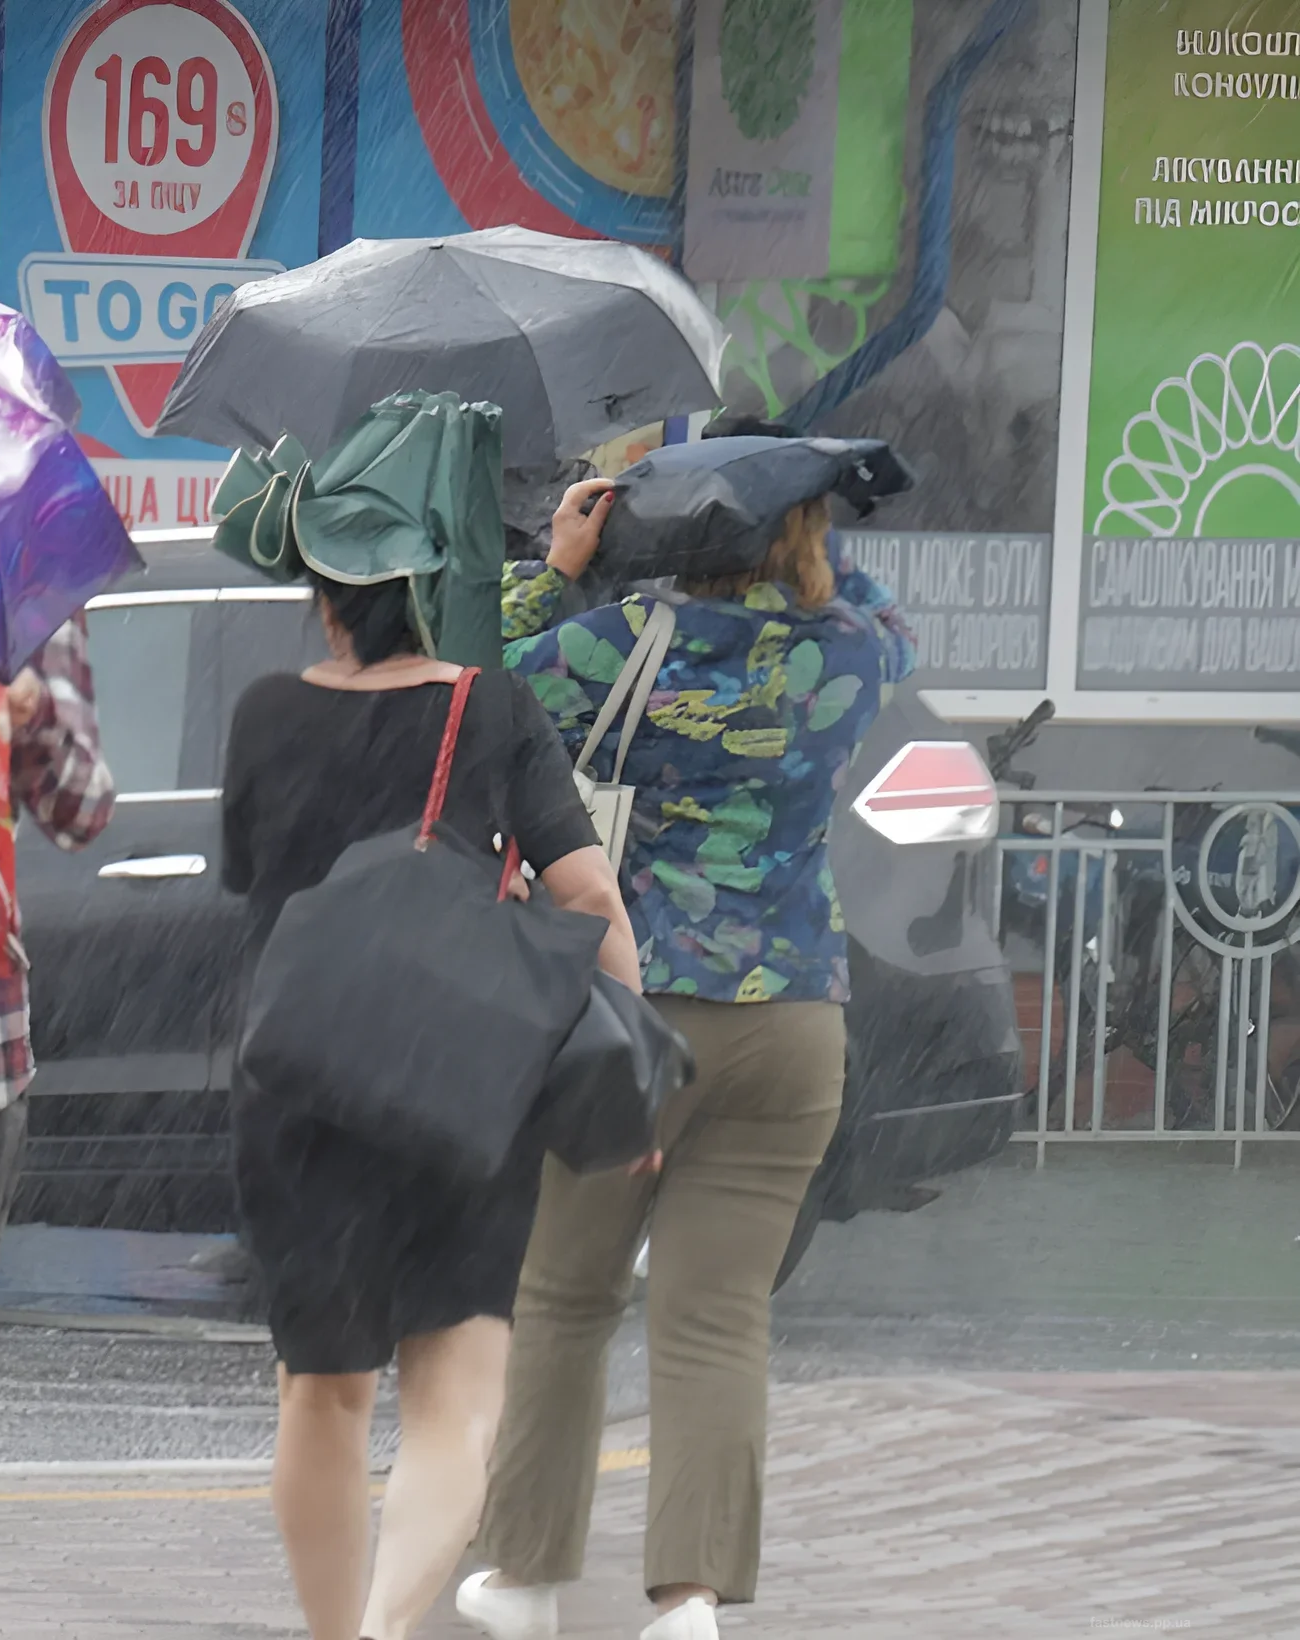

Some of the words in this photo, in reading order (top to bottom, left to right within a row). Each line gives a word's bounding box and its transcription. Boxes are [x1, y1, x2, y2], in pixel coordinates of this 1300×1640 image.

[94, 53, 218, 167] 169
[43, 279, 142, 342] TO
[906, 538, 976, 607] МОЖЕ
[982, 540, 1044, 608] БУТИ
[1089, 541, 1276, 609] САМОЛІКУВАННЯ
